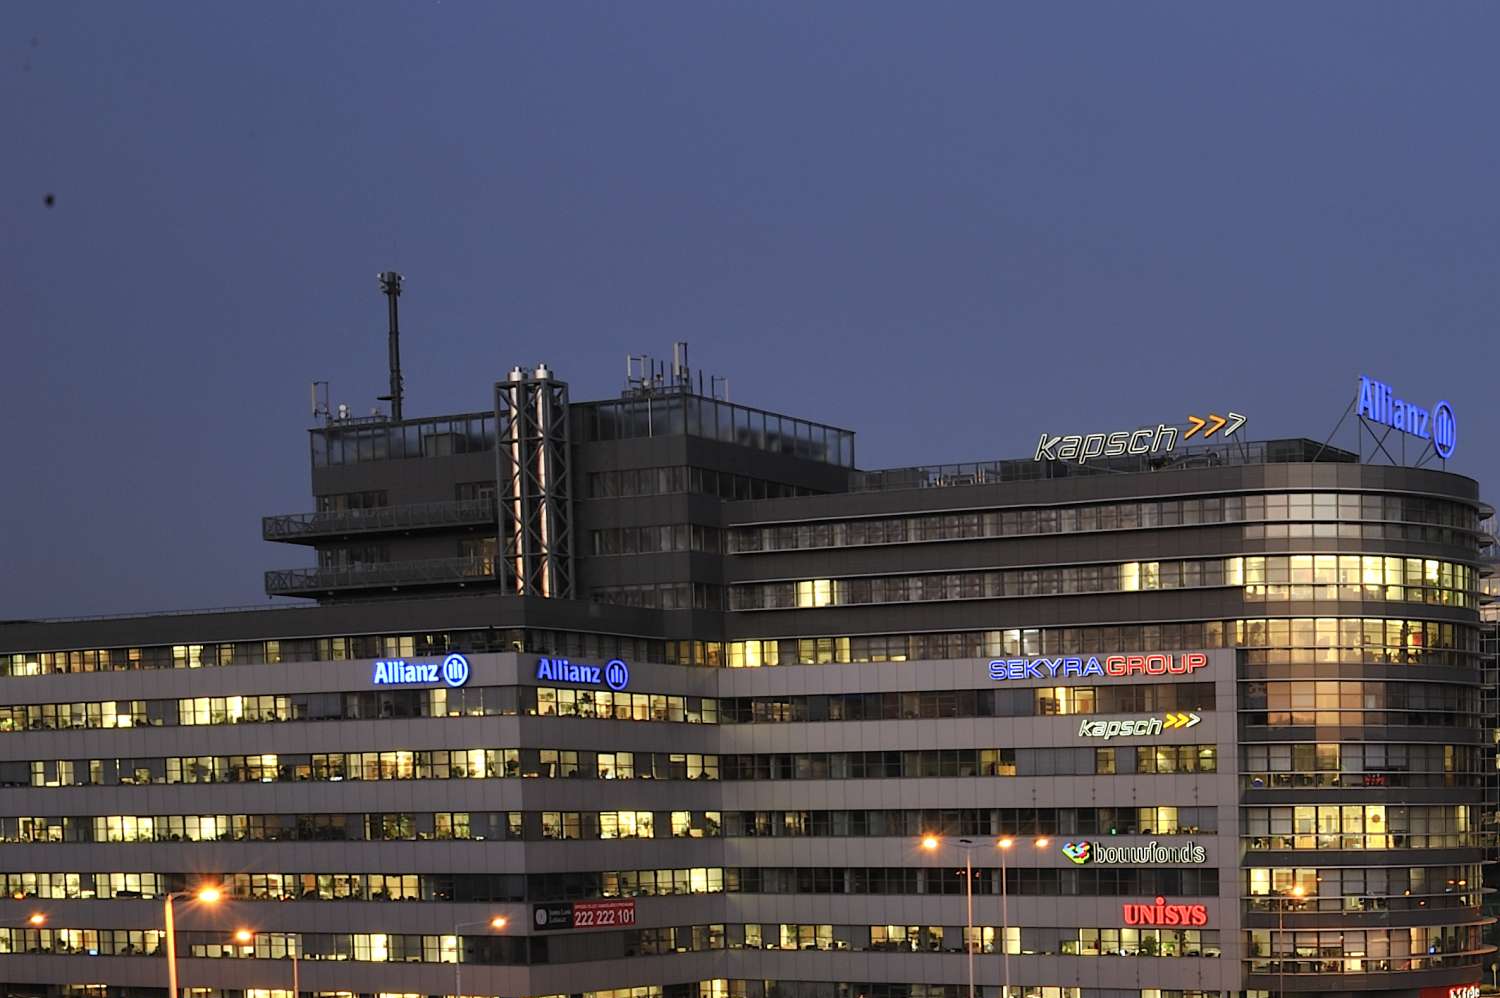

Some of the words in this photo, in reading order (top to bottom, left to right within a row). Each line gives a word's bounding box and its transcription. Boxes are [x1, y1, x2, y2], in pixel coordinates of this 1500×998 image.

[1357, 375, 1431, 440] Allianz
[1033, 422, 1178, 465] kapsch
[374, 660, 439, 684] Allianz
[537, 658, 601, 685] Allianz
[1078, 716, 1163, 740] kapsch
[1093, 840, 1206, 864] bouwfonds
[574, 911, 594, 926] 222
[596, 909, 615, 925] 222
[617, 908, 635, 924] 101
